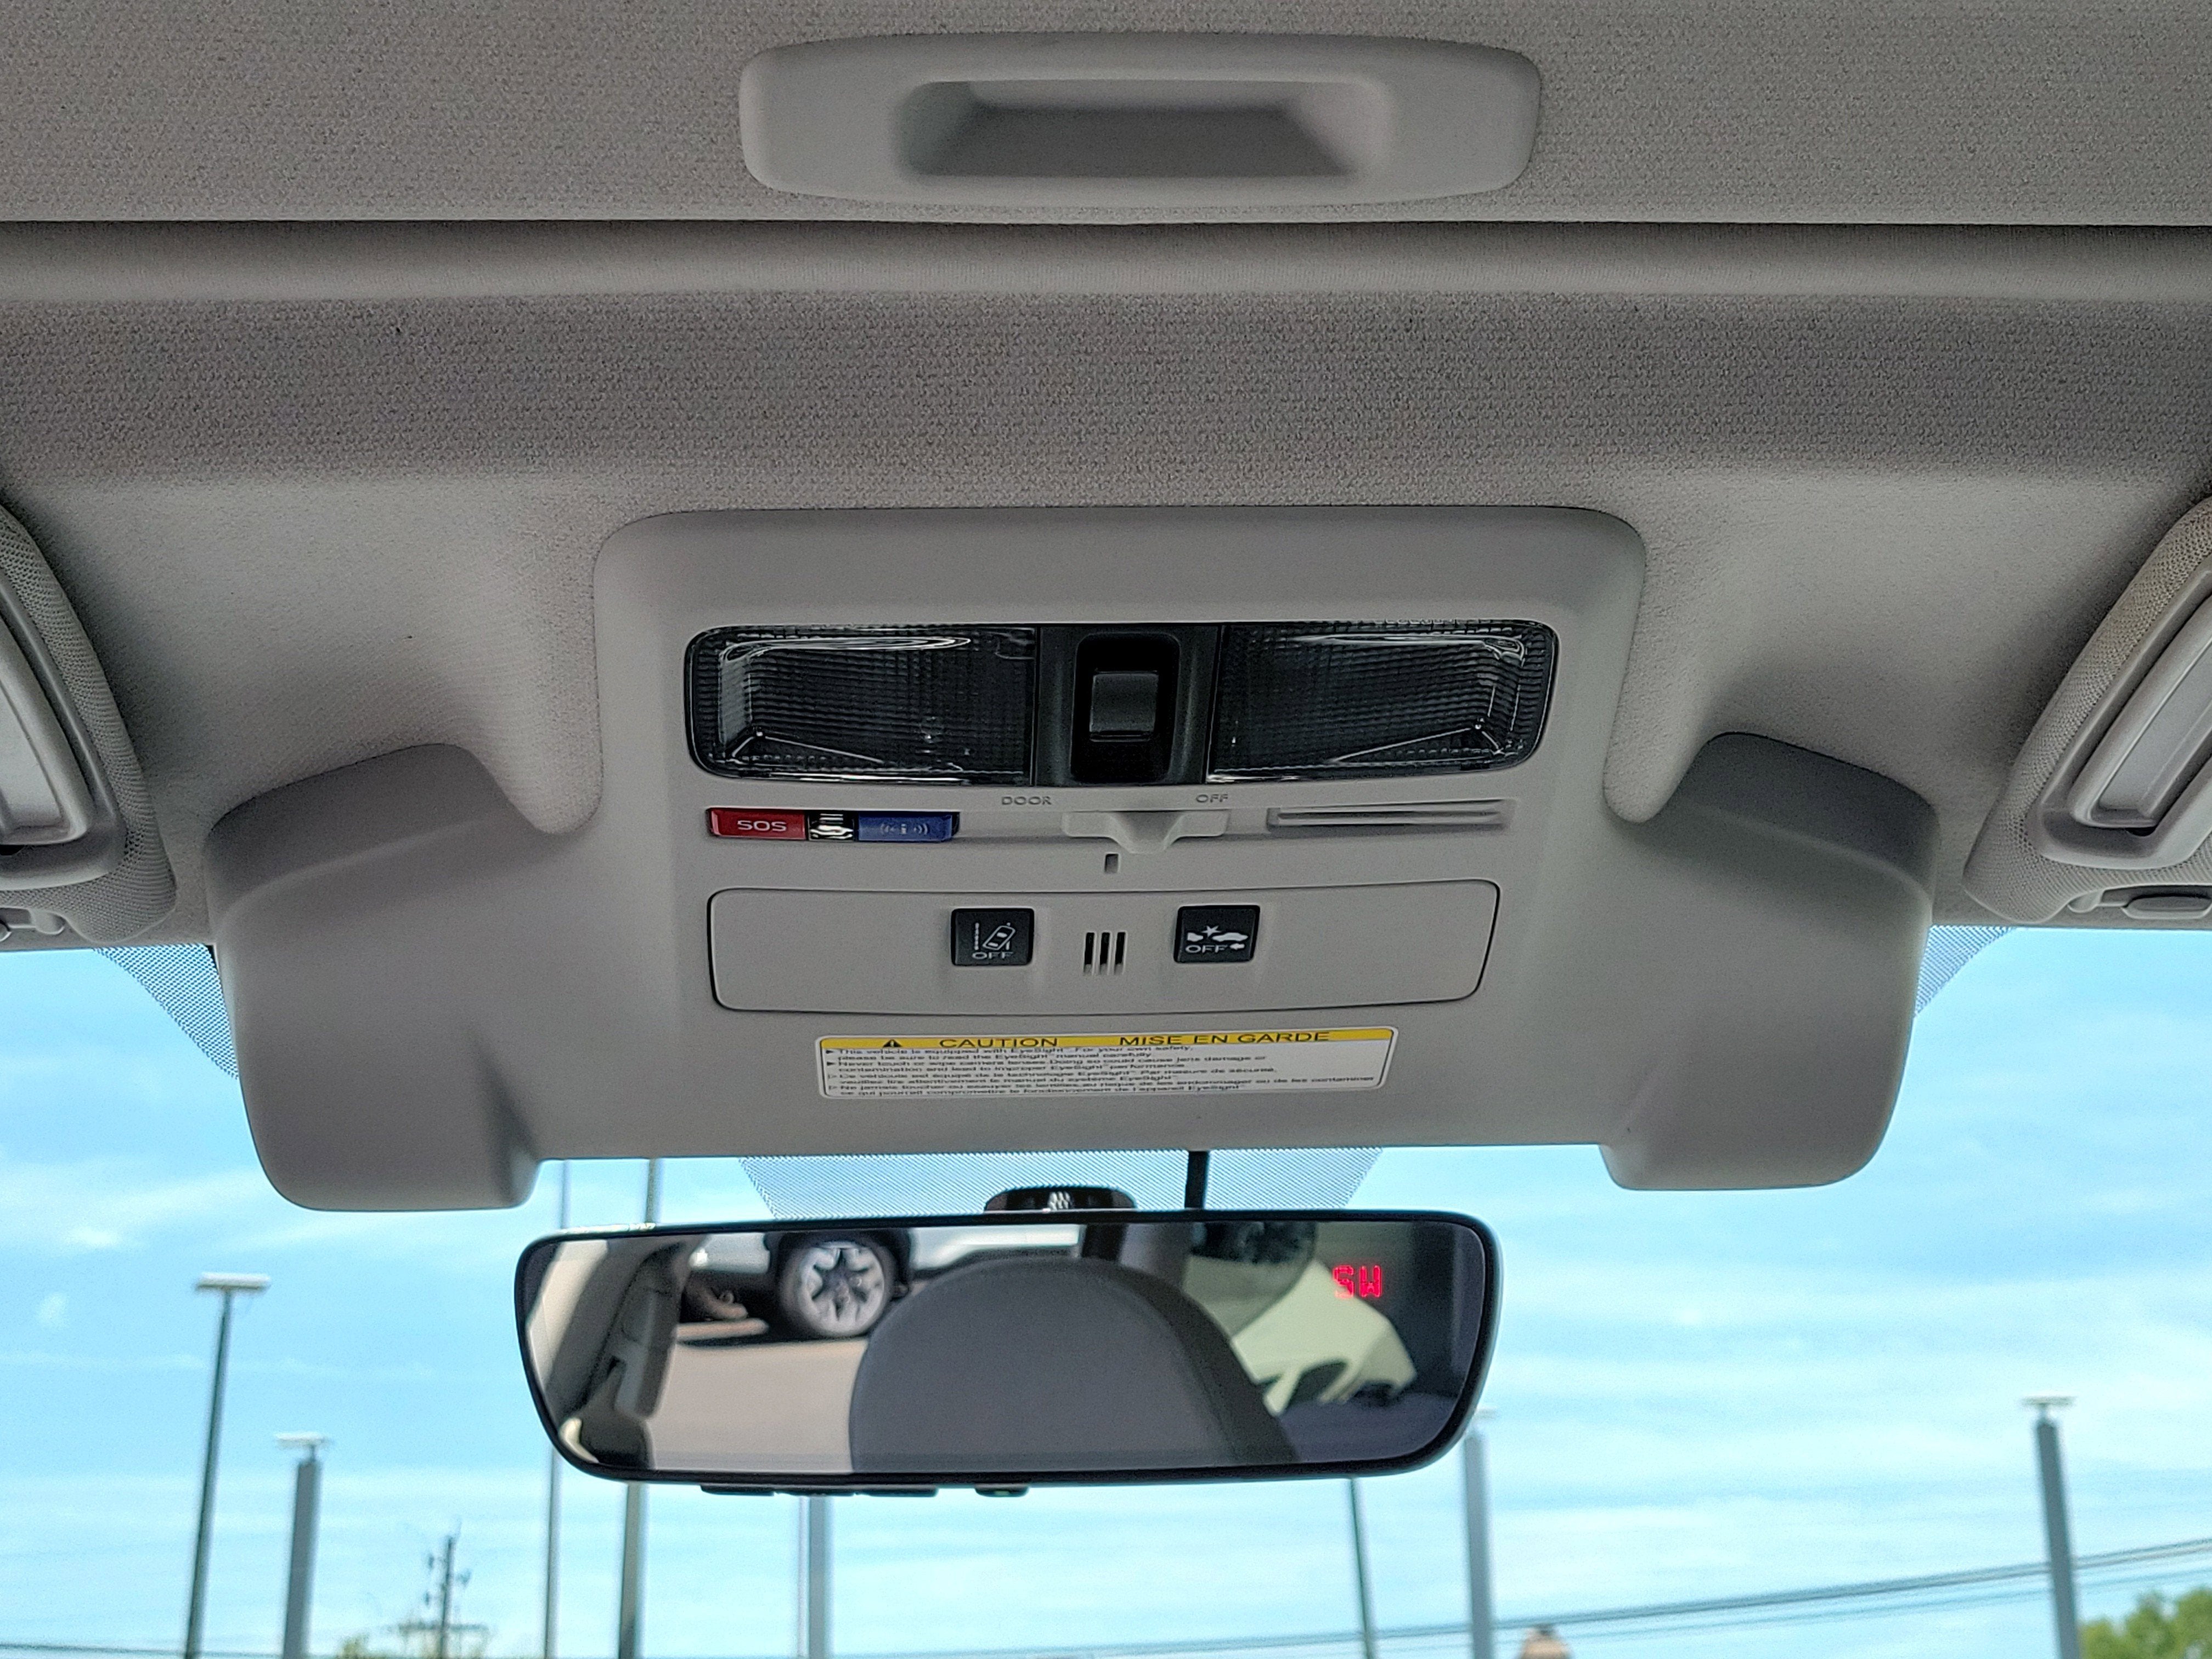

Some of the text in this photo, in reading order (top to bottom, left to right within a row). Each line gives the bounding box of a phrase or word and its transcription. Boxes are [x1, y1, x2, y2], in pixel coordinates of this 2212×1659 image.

[1001, 796, 1052, 805] DOOR
[1196, 794, 1228, 803] OFF
[737, 820, 787, 831] SOS
[1186, 944, 1227, 953] OFF
[972, 951, 1013, 960] OFF
[939, 1032, 1330, 1048] CAUTION MISE EN GARDE
[1333, 1265, 1381, 1299] SW
